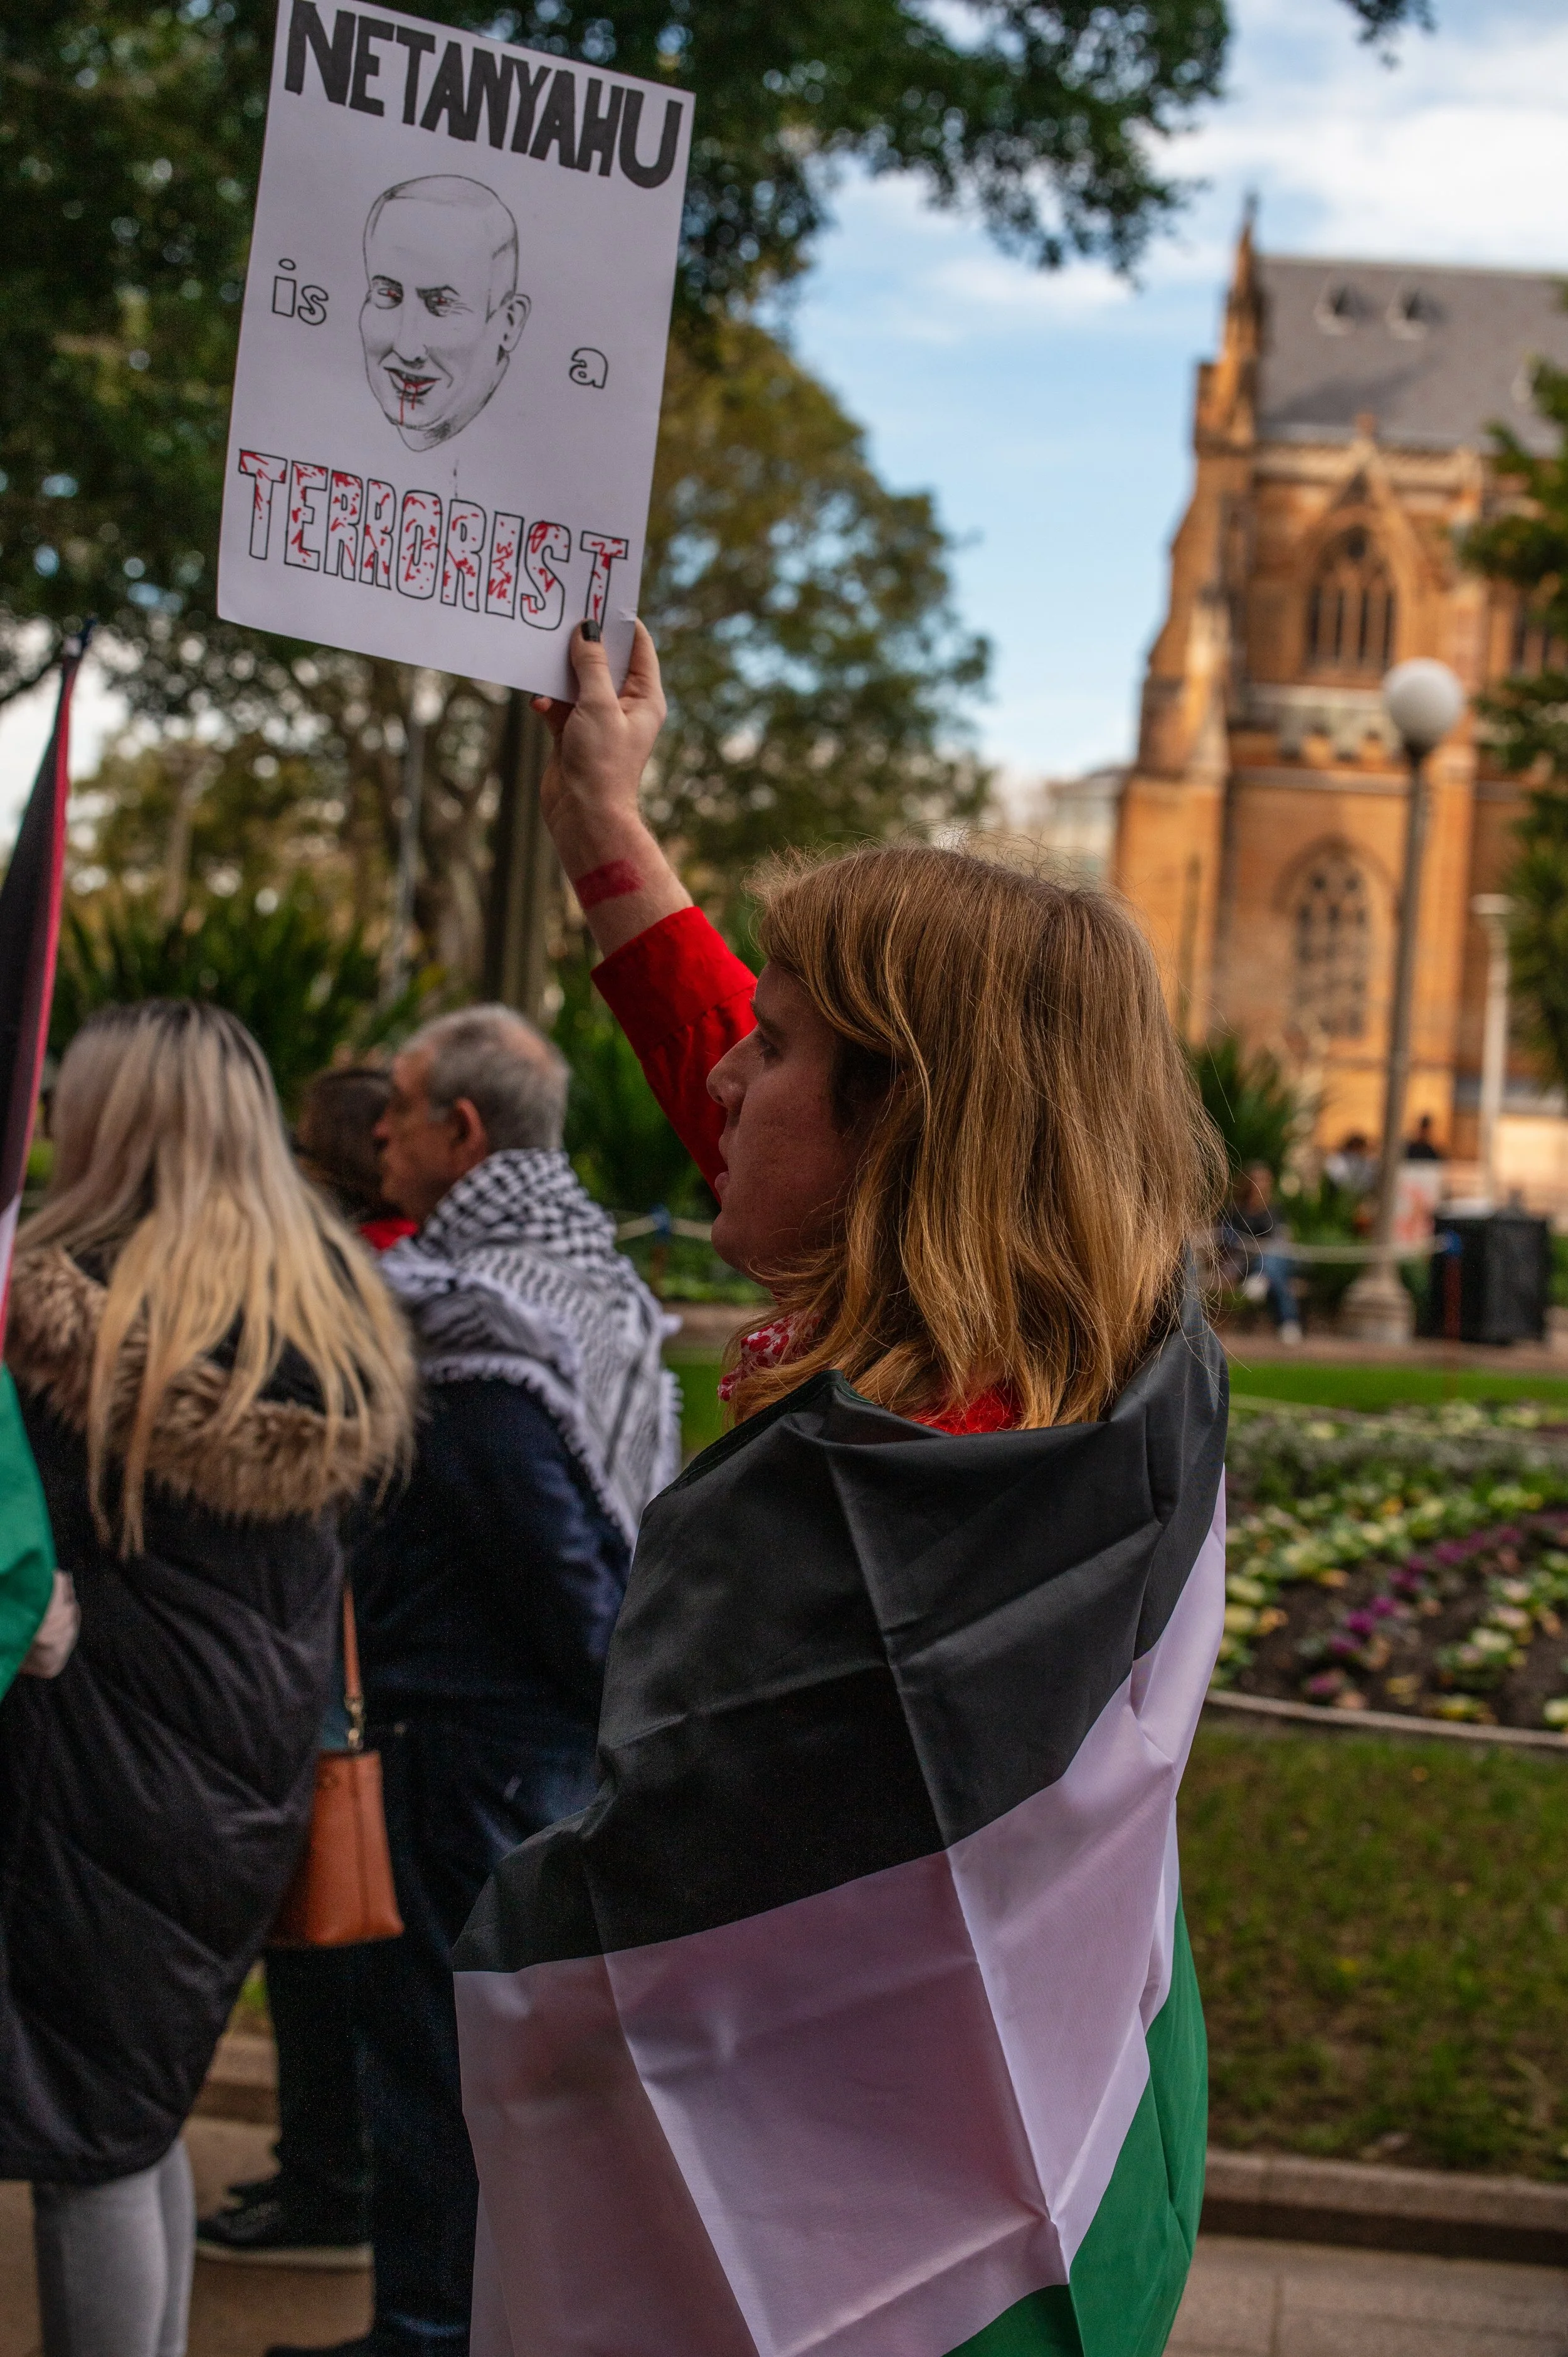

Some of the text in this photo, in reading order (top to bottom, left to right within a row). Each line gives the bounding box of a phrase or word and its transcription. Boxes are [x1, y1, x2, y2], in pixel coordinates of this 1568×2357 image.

[285, 0, 683, 189] NETANYAHU
[272, 258, 609, 389] is a
[238, 449, 629, 630] TERRORIST
